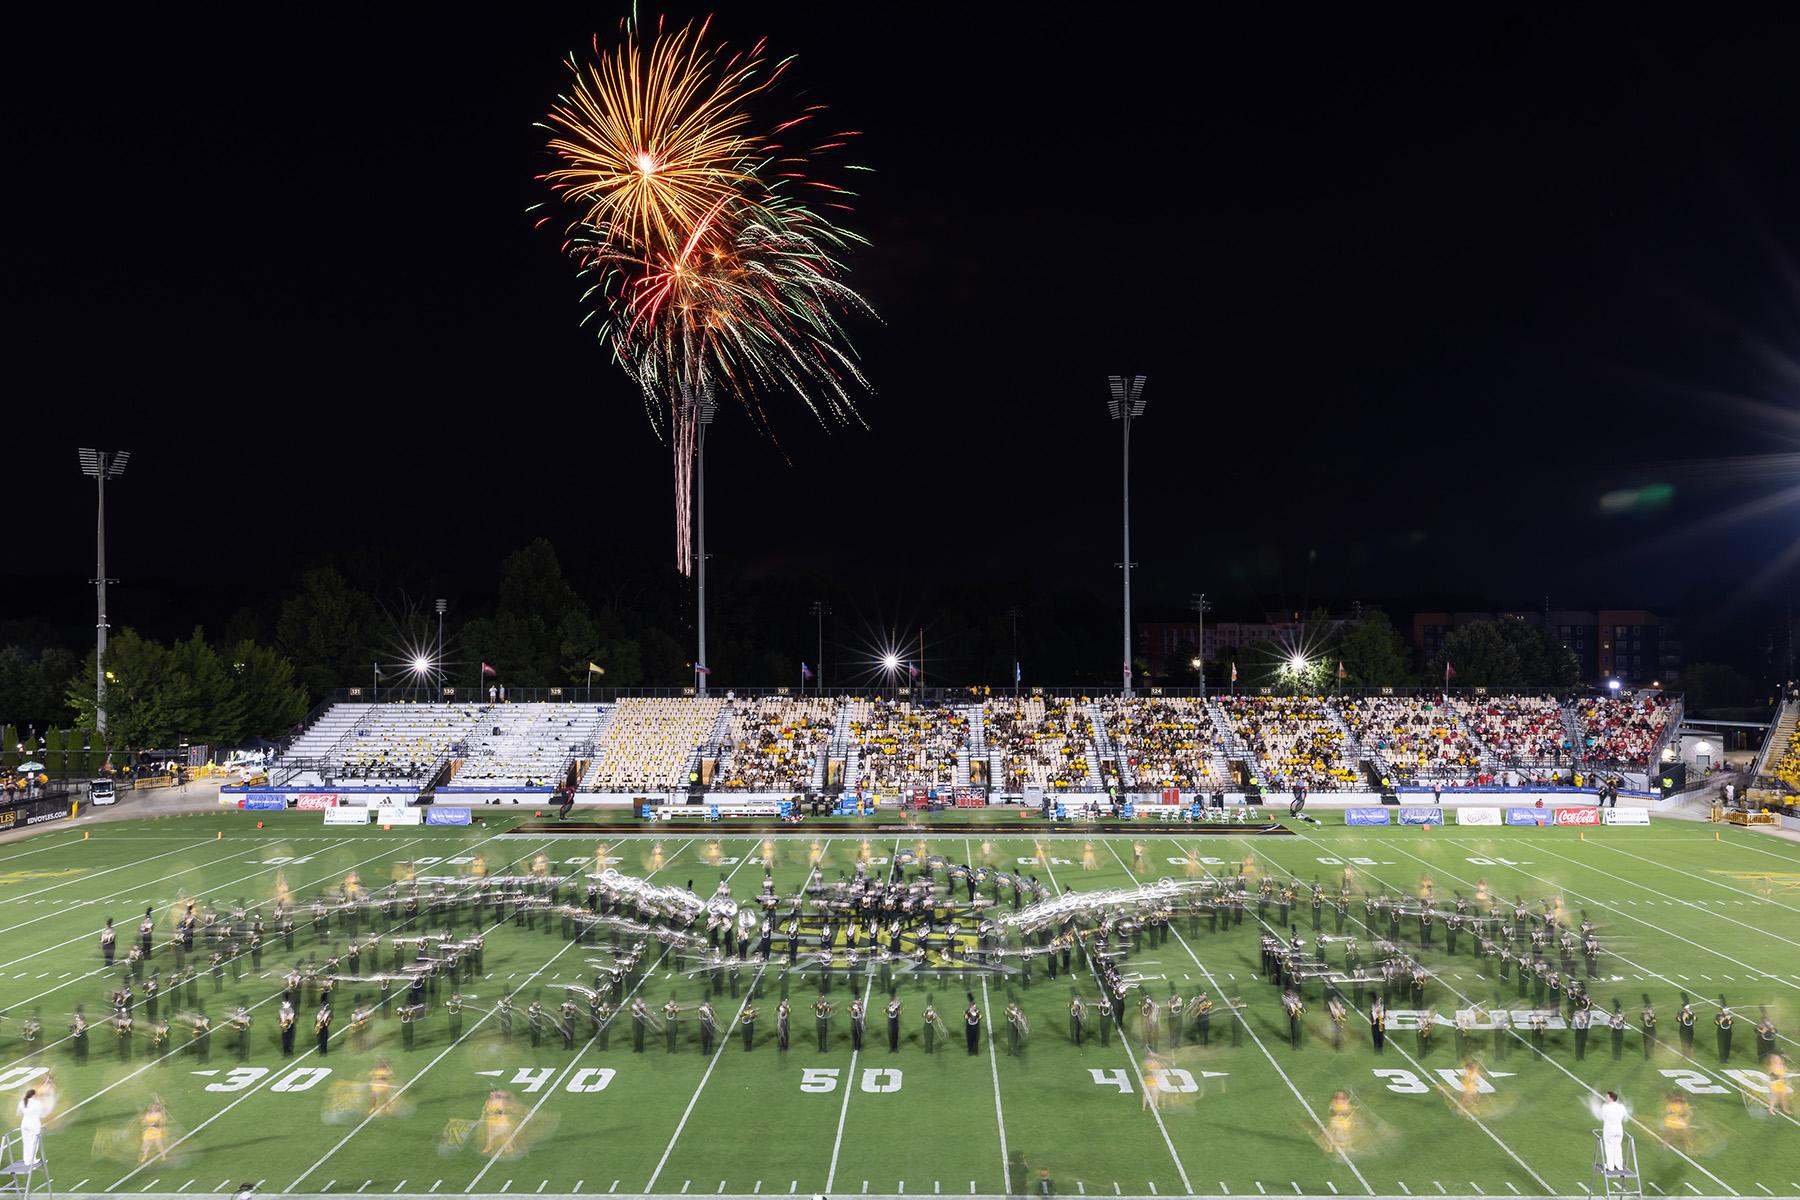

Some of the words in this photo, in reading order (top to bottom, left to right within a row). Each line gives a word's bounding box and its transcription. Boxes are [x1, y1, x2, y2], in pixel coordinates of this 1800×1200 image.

[299, 796, 335, 809] Coca-Cola
[27, 810, 67, 824] EDVOYLES.COM
[1559, 810, 1596, 824] Coca-Cola
[0, 1067, 50, 1090] 0
[205, 1068, 332, 1092] 30
[510, 1068, 616, 1092] 40
[800, 1068, 902, 1093] 50
[1088, 1068, 1199, 1093] 40
[1372, 1069, 1496, 1094] 30
[1657, 1069, 1794, 1094] 20
